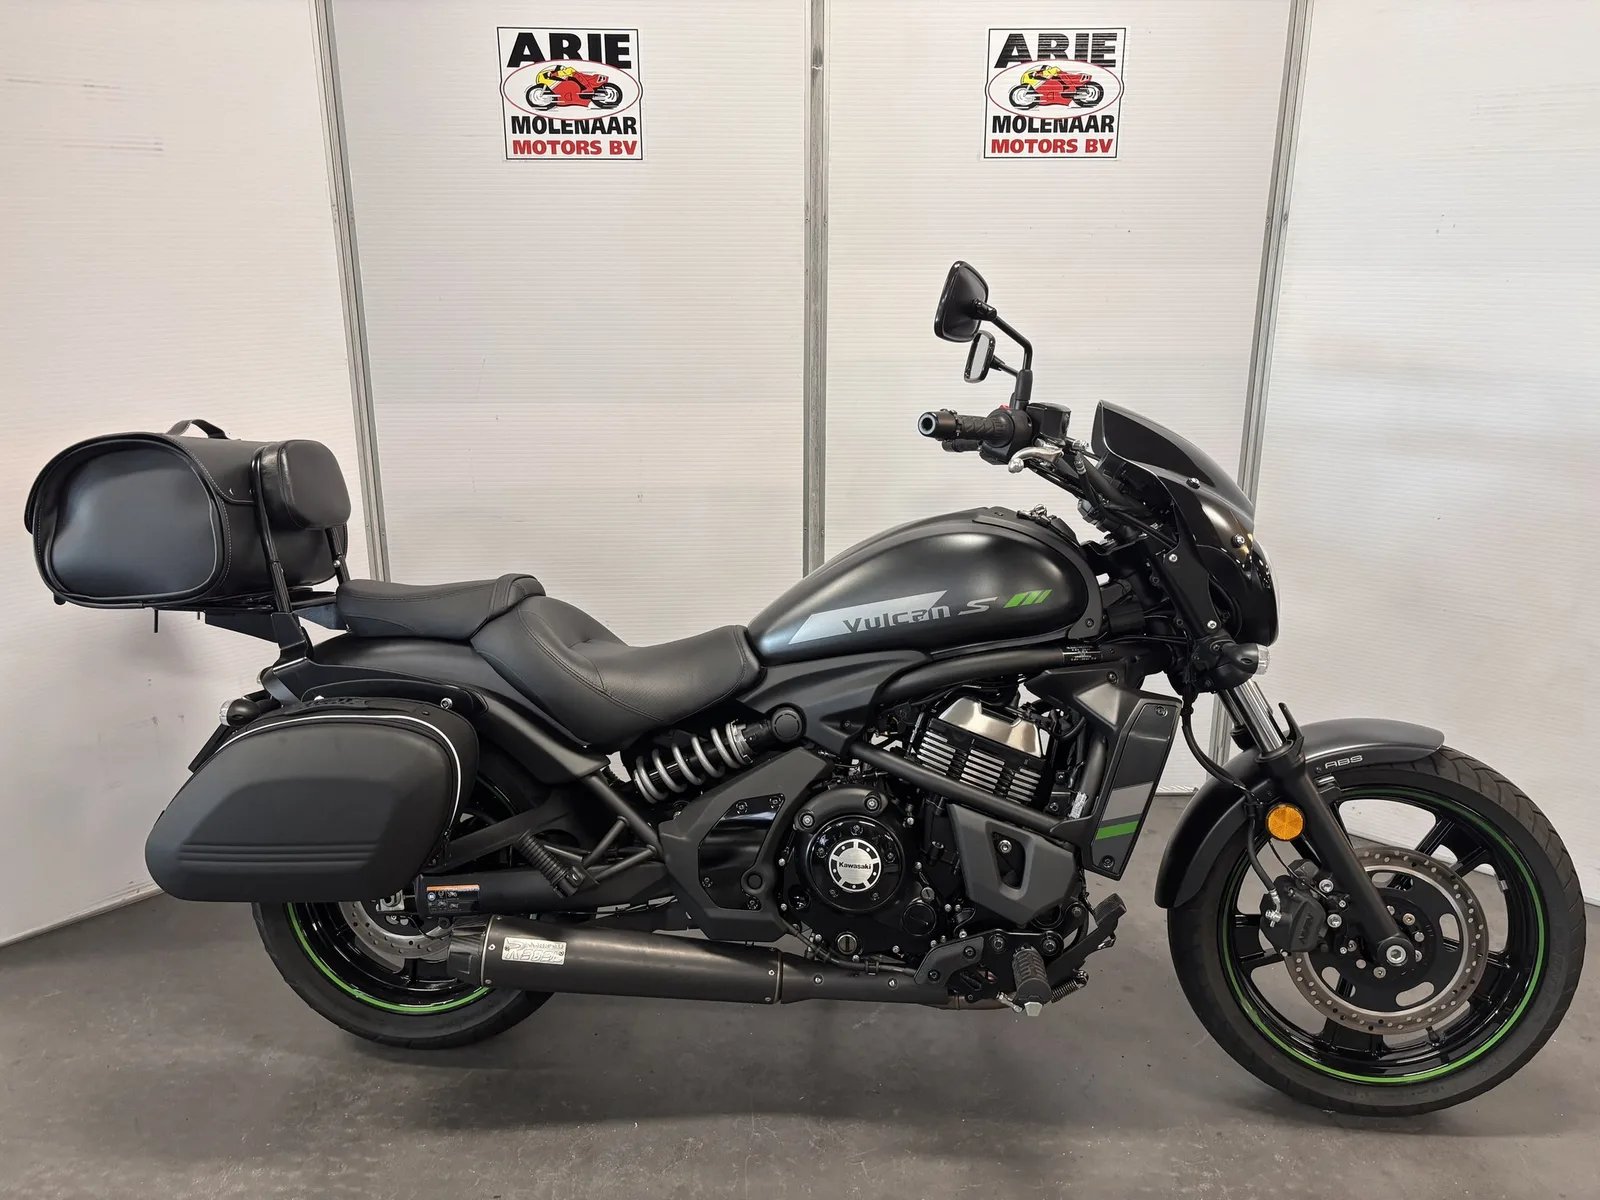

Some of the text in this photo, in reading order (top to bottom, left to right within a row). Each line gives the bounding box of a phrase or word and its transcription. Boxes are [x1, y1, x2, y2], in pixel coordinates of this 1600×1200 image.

[507, 32, 632, 69] ARIE
[994, 33, 1118, 68] ARIE
[511, 116, 637, 135] MOLENAAR
[992, 115, 1115, 134] MOLENAAR
[512, 140, 638, 155] MOTORS BV
[991, 138, 1113, 154] MOTORS BV
[842, 596, 998, 633] Vulcan S
[1324, 754, 1363, 770] ABS
[838, 861, 872, 870] Kawasaki
